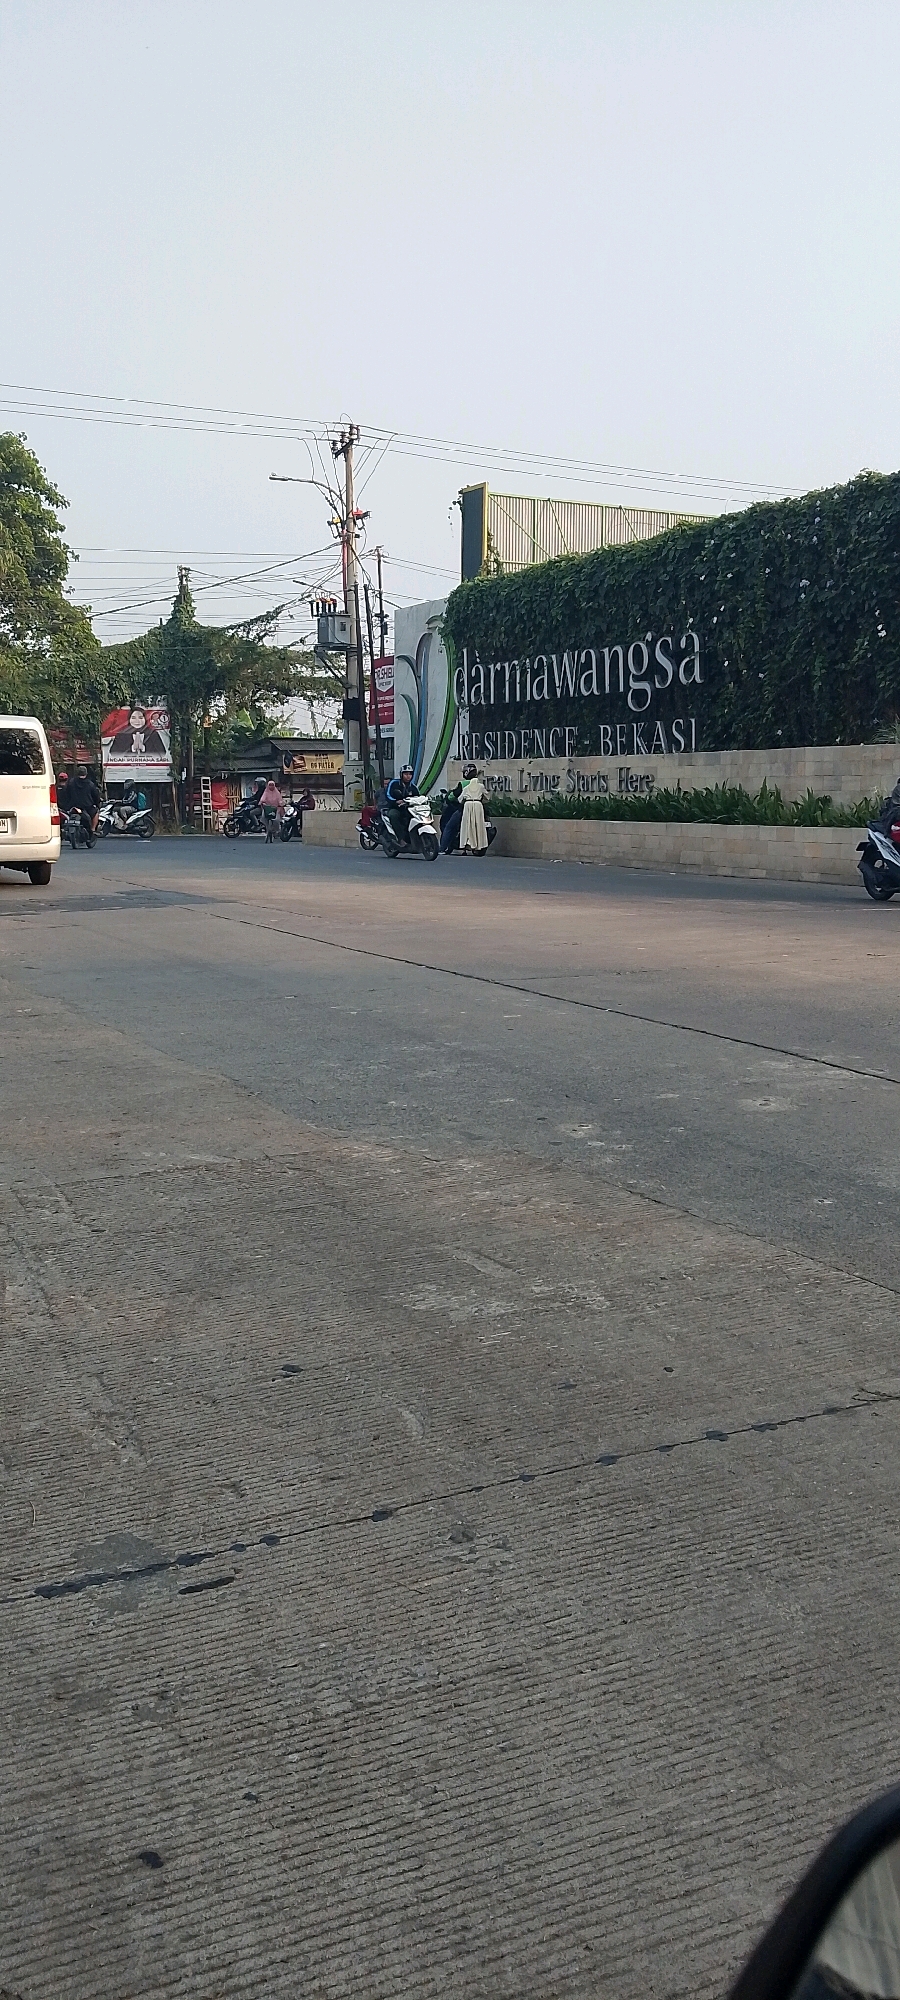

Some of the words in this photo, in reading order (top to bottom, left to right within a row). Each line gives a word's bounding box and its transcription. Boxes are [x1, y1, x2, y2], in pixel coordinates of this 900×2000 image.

[453, 631, 704, 712] darmawangsa
[458, 726, 578, 760] RESIDENCE
[598, 718, 697, 757] BEKASI
[517, 769, 561, 793] Living
[566, 768, 609, 793] Starts
[616, 766, 656, 792] Here
